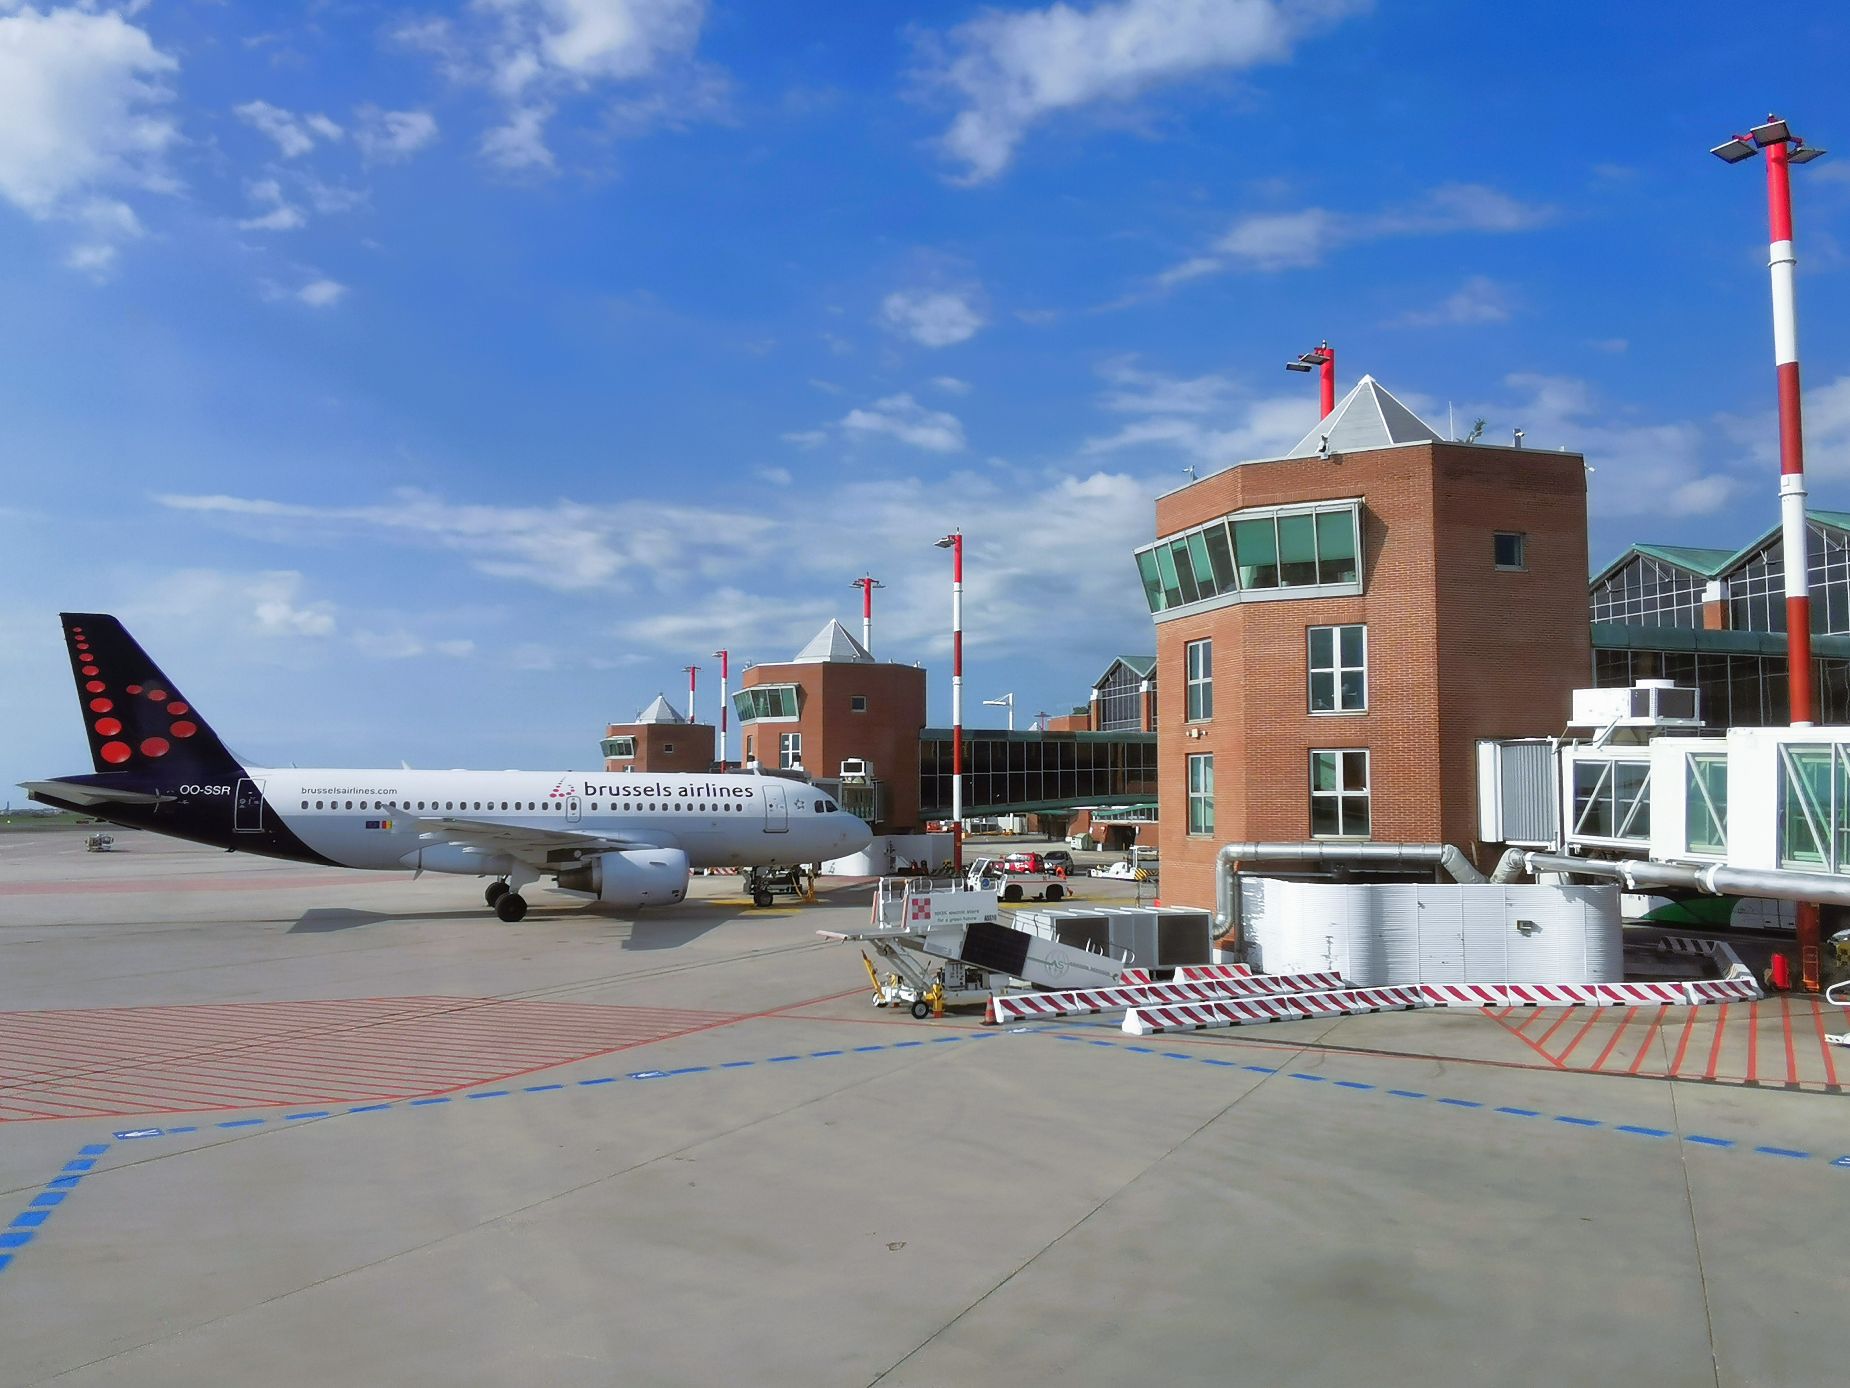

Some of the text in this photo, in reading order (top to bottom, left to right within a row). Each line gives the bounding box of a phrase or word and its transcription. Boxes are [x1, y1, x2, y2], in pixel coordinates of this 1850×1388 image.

[179, 784, 231, 796] OO-SSR
[301, 786, 398, 795] brusselsairlines.com
[584, 781, 754, 798] brussels airlines
